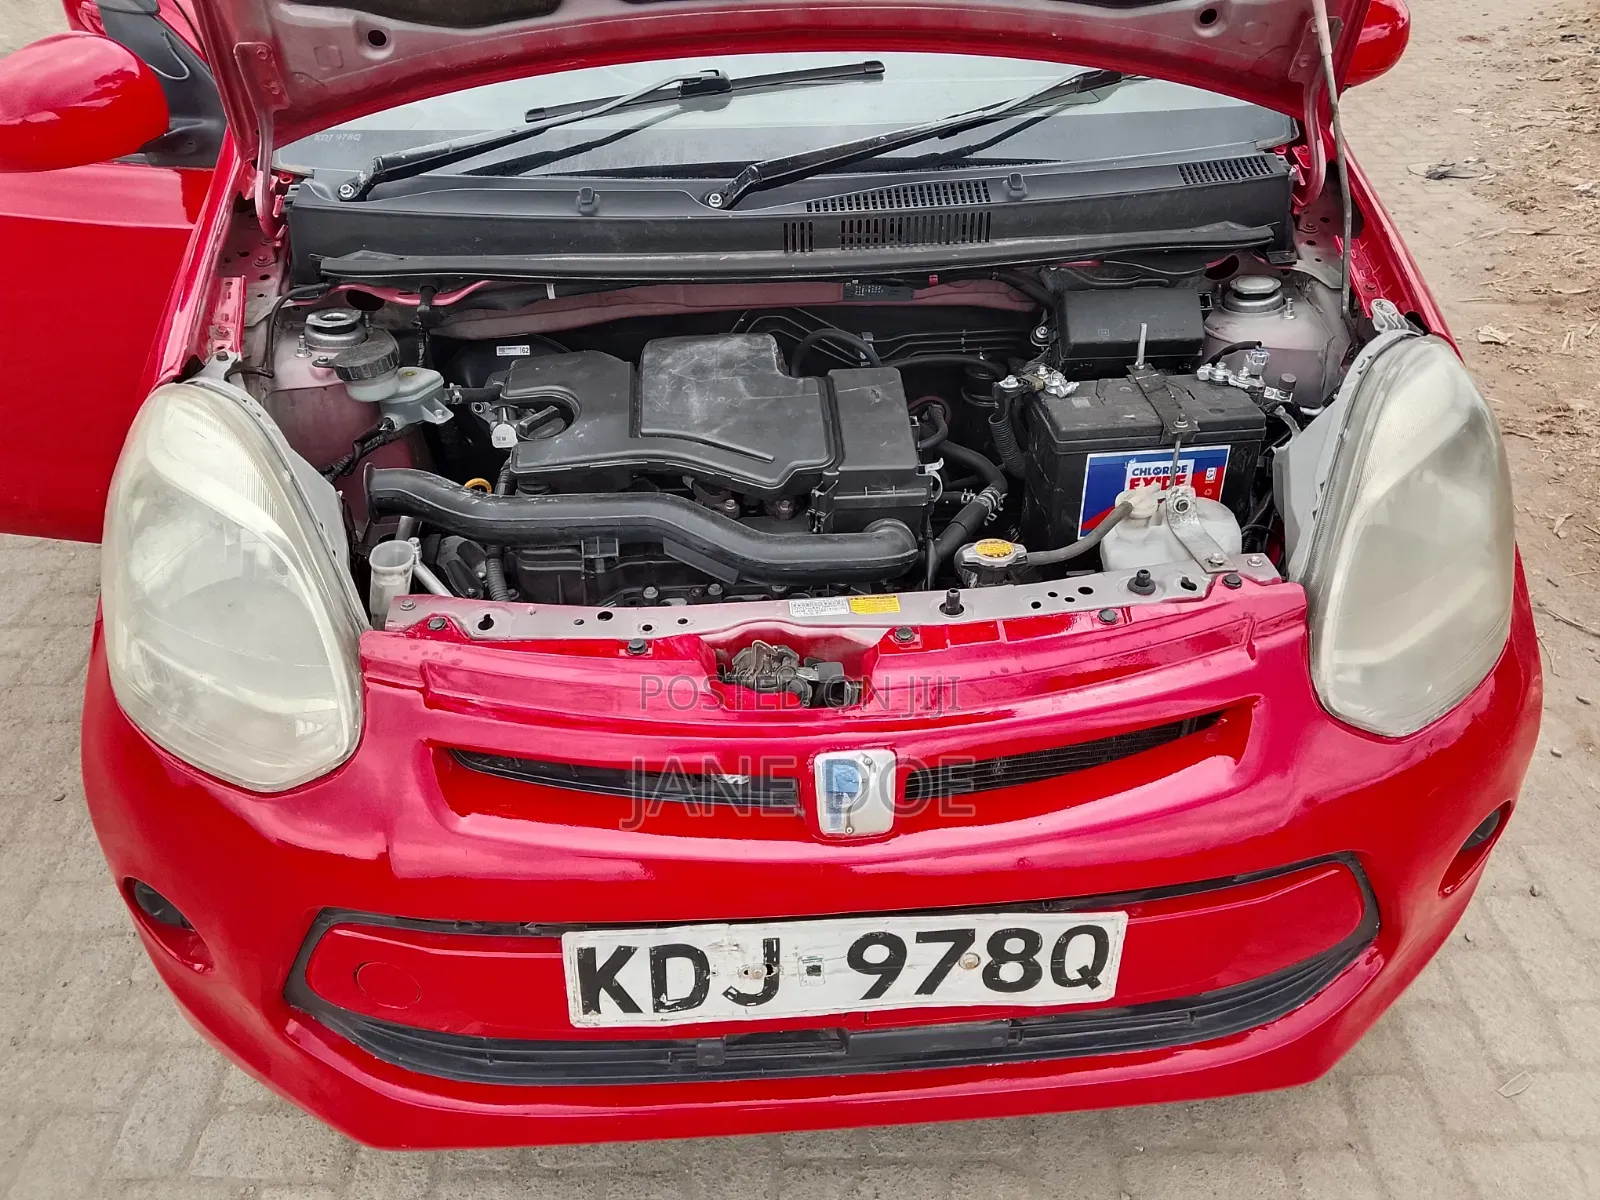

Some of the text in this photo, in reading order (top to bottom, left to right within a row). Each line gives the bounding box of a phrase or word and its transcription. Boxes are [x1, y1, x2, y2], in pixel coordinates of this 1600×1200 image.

[1132, 465, 1188, 476] CHLORIDE
[577, 925, 1110, 1014] KDJ 978Q
